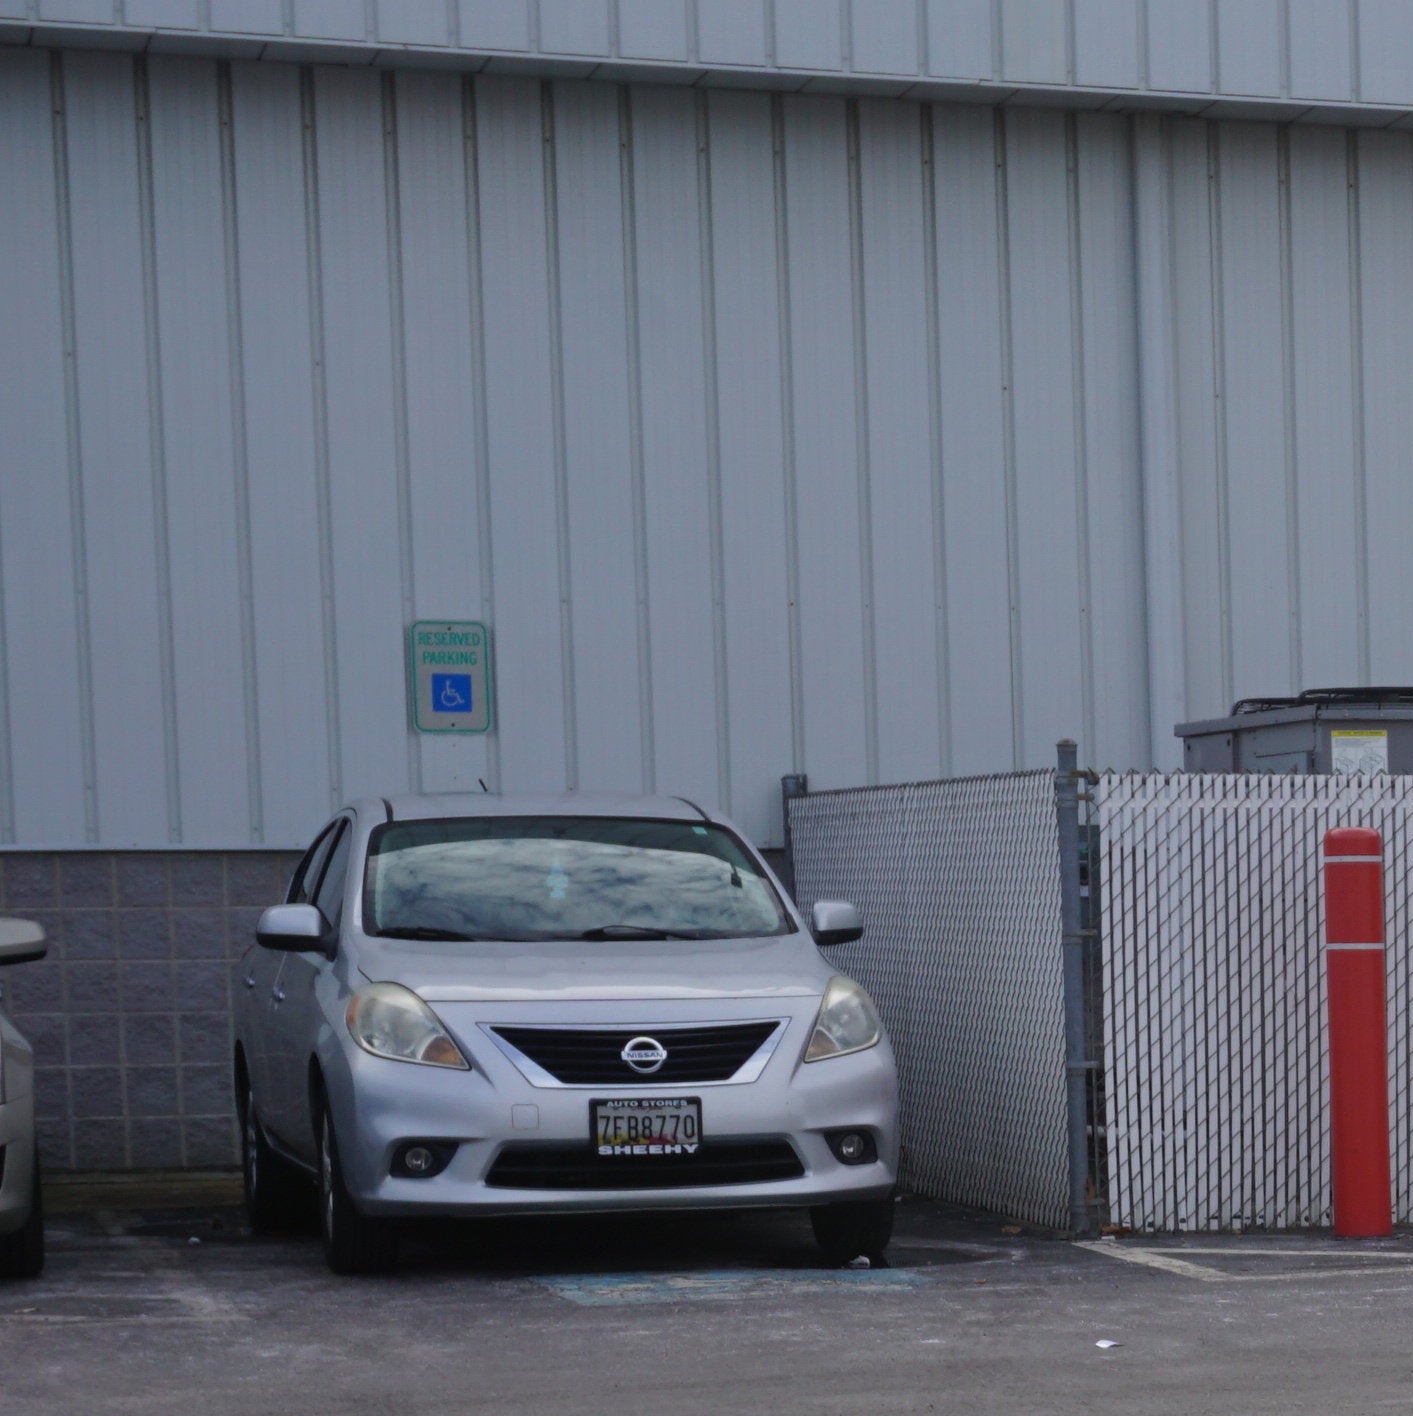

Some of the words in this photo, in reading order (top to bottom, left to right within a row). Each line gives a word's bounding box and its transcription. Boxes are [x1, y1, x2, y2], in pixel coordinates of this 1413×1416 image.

[418, 632, 481, 646] RESERVED
[423, 651, 478, 665] PARKING
[626, 1051, 664, 1059] NISSAN
[607, 1100, 638, 1108] AUTO
[599, 1114, 696, 1141] 7FB8770
[598, 1144, 700, 1156] SHEEHY
